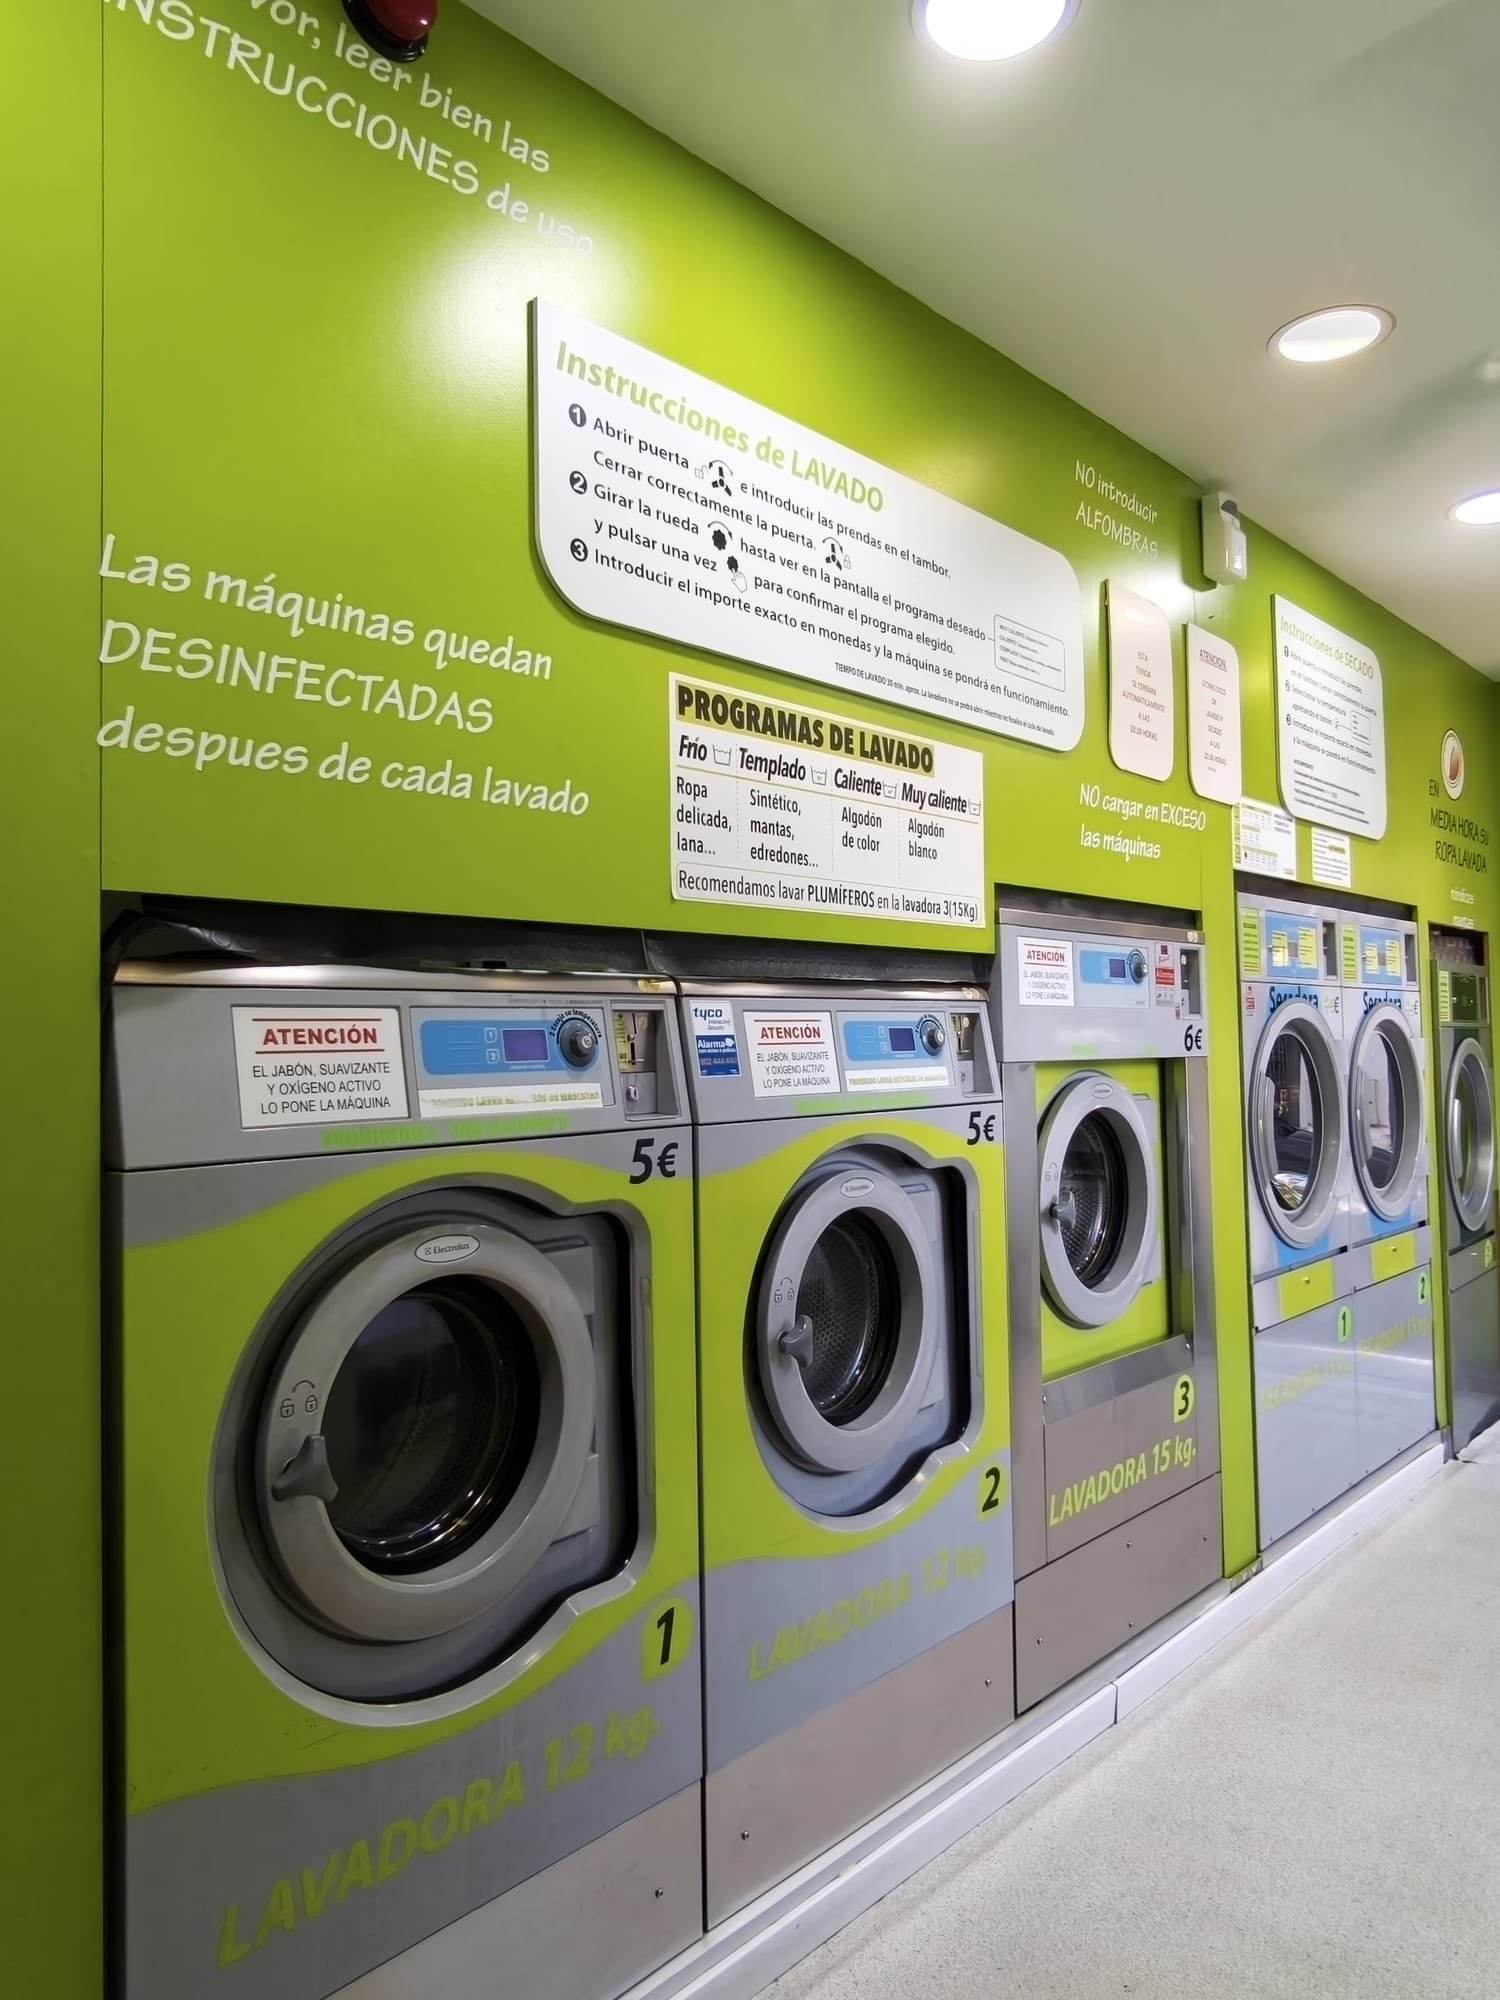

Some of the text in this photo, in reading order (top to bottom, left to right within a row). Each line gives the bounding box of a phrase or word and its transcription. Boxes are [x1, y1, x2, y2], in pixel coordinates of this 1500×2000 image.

[335, 23, 412, 91] leer
[419, 73, 493, 143] bien
[501, 119, 551, 173] las
[486, 183, 530, 223] de
[538, 212, 594, 256] uso
[556, 340, 884, 512] Instrucciones de LAVADO
[593, 417, 951, 579] Abrir puerta e introducir las prendas en el tambor.
[593, 450, 816, 550] Cerrar correctamente la puerta.
[1075, 460, 1158, 524] NO introducir
[1075, 502, 1159, 561] ALFOMBRAS
[594, 483, 634, 511] Girar
[638, 498, 651, 517] la
[656, 510, 700, 535] rueda
[740, 538, 776, 564] hasta
[779, 556, 800, 571] ver
[802, 565, 817, 579] en
[820, 568, 831, 583] la
[834, 577, 880, 601] pantalla
[882, 594, 892, 606] el
[894, 599, 944, 628] programa
[946, 616, 987, 642] deseado
[594, 519, 955, 656] y pulsar una vez para confirmar el programa elegido.
[99, 533, 553, 680] Las máquinas quedan
[594, 548, 1070, 718] Introducir el importe exacto en monedas y la máquina se pondrá en funcionamiento.
[1281, 615, 1334, 657] Instrucciones
[1335, 646, 1344, 662] de
[1344, 652, 1374, 679] SECADO
[98, 619, 494, 734] DESINFECTADAS
[835, 662, 886, 685] TIEMPO LAVADO
[678, 684, 934, 773] PROGRAMAS DE LAVADO
[97, 705, 590, 816] despues de cada lavado
[679, 734, 968, 814] Frío Templado Caliente Muy caliente
[676, 776, 708, 800] Ropa
[750, 788, 801, 817] Sintético,
[676, 804, 732, 833] delicada,
[841, 806, 882, 830] Algodón
[1079, 783, 1206, 831] NO cargar en EXCESO
[1430, 807, 1480, 842] MEDIA HORA
[676, 831, 716, 856] lana...
[750, 818, 795, 841] mantas,
[841, 831, 880, 852] de color
[908, 817, 945, 839] Algodón
[1080, 824, 1161, 862] las máquinas
[750, 843, 819, 869] edredones...
[908, 840, 938, 861] blanco
[1435, 840, 1487, 875] ROPA LAVADA
[678, 869, 776, 900] Recomendamos
[778, 881, 805, 902] lavar
[807, 882, 875, 909] PLUMÍFEROS
[877, 897, 890, 910] en
[892, 894, 899, 910] la
[901, 895, 941, 915] lavadora
[693, 1007, 723, 1021] tyco
[761, 1024, 821, 1039] ATENCIÓN
[263, 1024, 377, 1045] ATENCIÓN
[698, 1039, 726, 1049] Alarma
[1184, 1025, 1203, 1052] 6€
[253, 1062, 391, 1078] EL JABÓN, SUAVIZANTE
[757, 1051, 830, 1063] EL JABÓN, SUAVIZANTE
[771, 1064, 825, 1075] OXÍGENO ACTIVO
[267, 1079, 382, 1096] Y OXÍGENO ACTIVO
[763, 1075, 831, 1089] LO PONE LA MÁQUINA
[260, 1096, 391, 1115] LO PONE LA MÁQUINA
[966, 1110, 996, 1146] 5€
[628, 1138, 679, 1185] 5€
[1419, 1276, 1426, 1300] 2
[1341, 1310, 1348, 1338] 1
[1177, 1380, 1190, 1416] 3
[982, 1466, 1001, 1512] 2
[1050, 1435, 1196, 1526] LAVADORA 15 kg.
[656, 1607, 676, 1666] 1
[747, 1571, 912, 1684] LAVADORA
[216, 1761, 526, 1970] LAVADORA
[543, 1721, 596, 1794] 12
